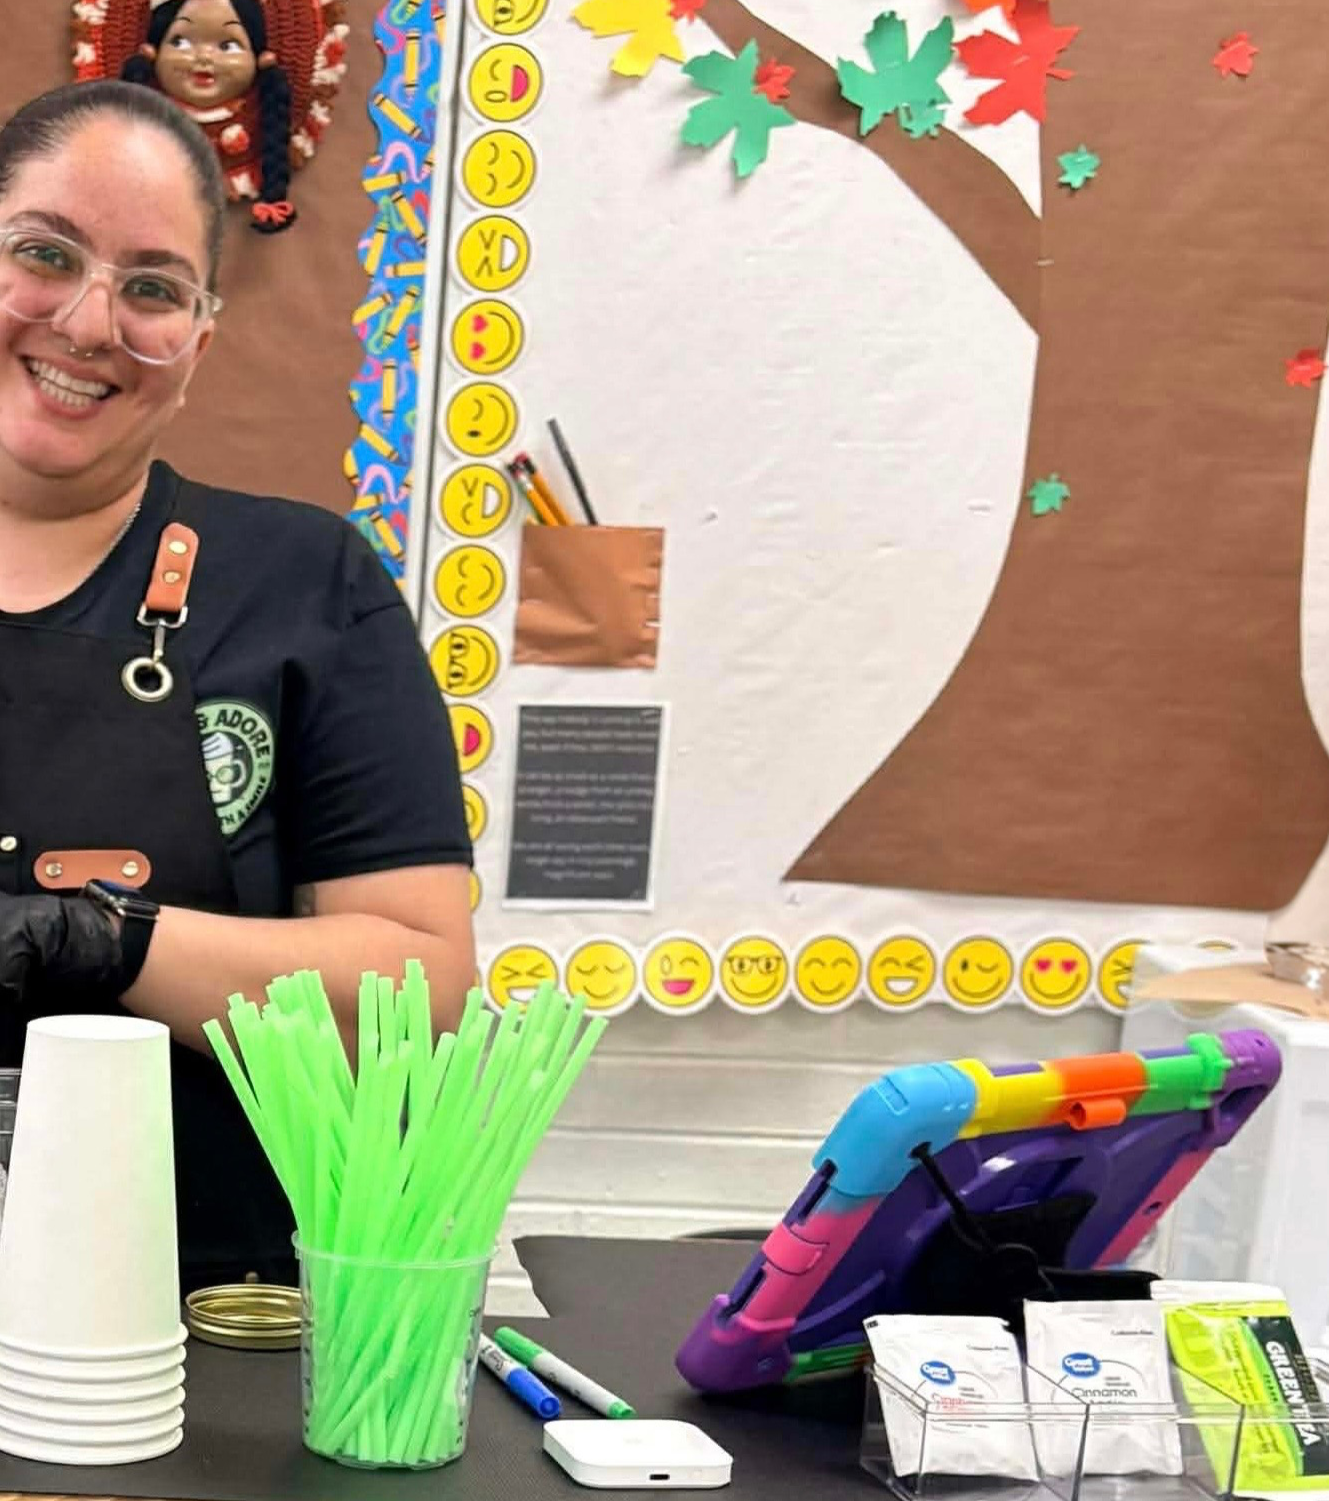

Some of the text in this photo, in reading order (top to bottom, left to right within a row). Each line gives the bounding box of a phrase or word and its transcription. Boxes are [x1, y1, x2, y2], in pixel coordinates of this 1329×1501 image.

[214, 709, 270, 758] ADORE
[1071, 1387, 1138, 1398] Cinnamon
[1266, 1341, 1306, 1404] GREEN
